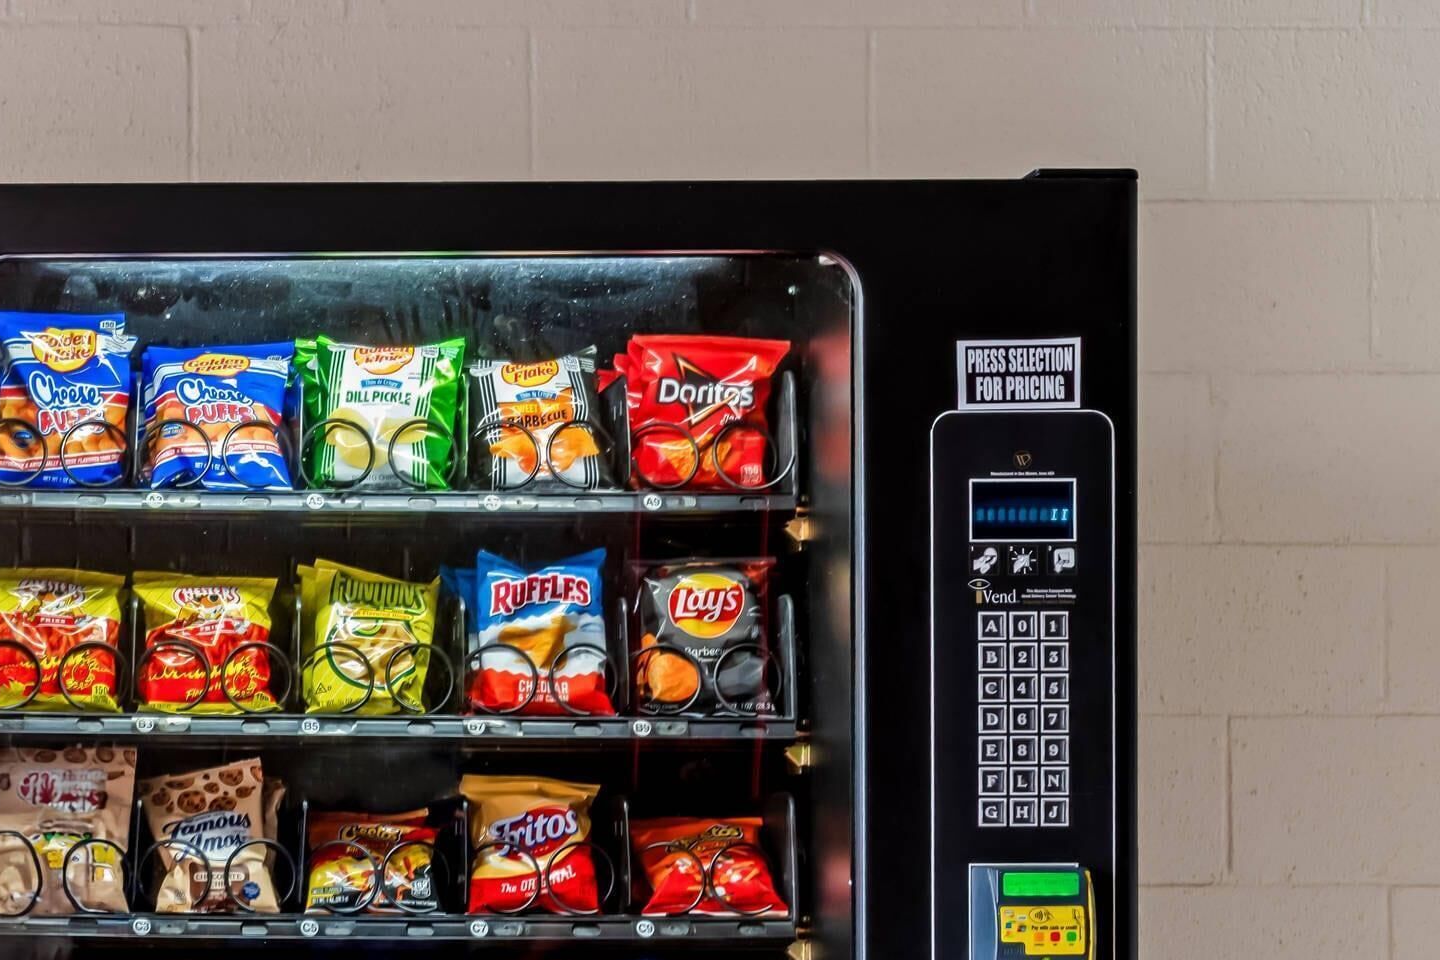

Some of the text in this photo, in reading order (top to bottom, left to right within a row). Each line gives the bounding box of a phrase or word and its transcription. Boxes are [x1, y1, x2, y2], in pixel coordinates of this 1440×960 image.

[967, 347, 1073, 373] PRESS SELECTION
[513, 365, 553, 383] Flake
[29, 371, 103, 410] Cheese
[658, 376, 755, 407] Doritos
[976, 375, 1065, 401] FOR PRICING
[345, 390, 412, 406] DILL PICKLE
[186, 403, 257, 424] PUFFS
[507, 409, 568, 428] BARBECUE
[39, 408, 105, 435] PUF
[490, 573, 592, 618] RUFFLES
[673, 587, 740, 623] Lay's
[985, 620, 998, 632] A
[1018, 620, 1027, 632] 0
[1049, 620, 1057, 632] 1
[685, 646, 731, 656] Barbec
[985, 651, 998, 664] B
[1018, 651, 1027, 664] 2
[1049, 651, 1058, 664] 3
[518, 679, 569, 693] CHDAR
[985, 682, 998, 694] C
[1018, 682, 1027, 694] 4
[1049, 682, 1058, 694] 5
[985, 713, 998, 725] D
[1018, 713, 1027, 725] 6
[1049, 713, 1058, 725] 7
[985, 744, 998, 757] E
[1018, 744, 1027, 757] 8
[1049, 744, 1058, 757] 9
[985, 775, 998, 787] F
[1016, 775, 1028, 787] L
[1047, 775, 1060, 787] N
[985, 806, 998, 818] G
[1016, 806, 1028, 818] H
[1049, 806, 1058, 818] J
[162, 812, 251, 845] Famous
[489, 809, 578, 857] Fritos
[177, 832, 246, 857] Amos
[501, 882, 517, 893] The
